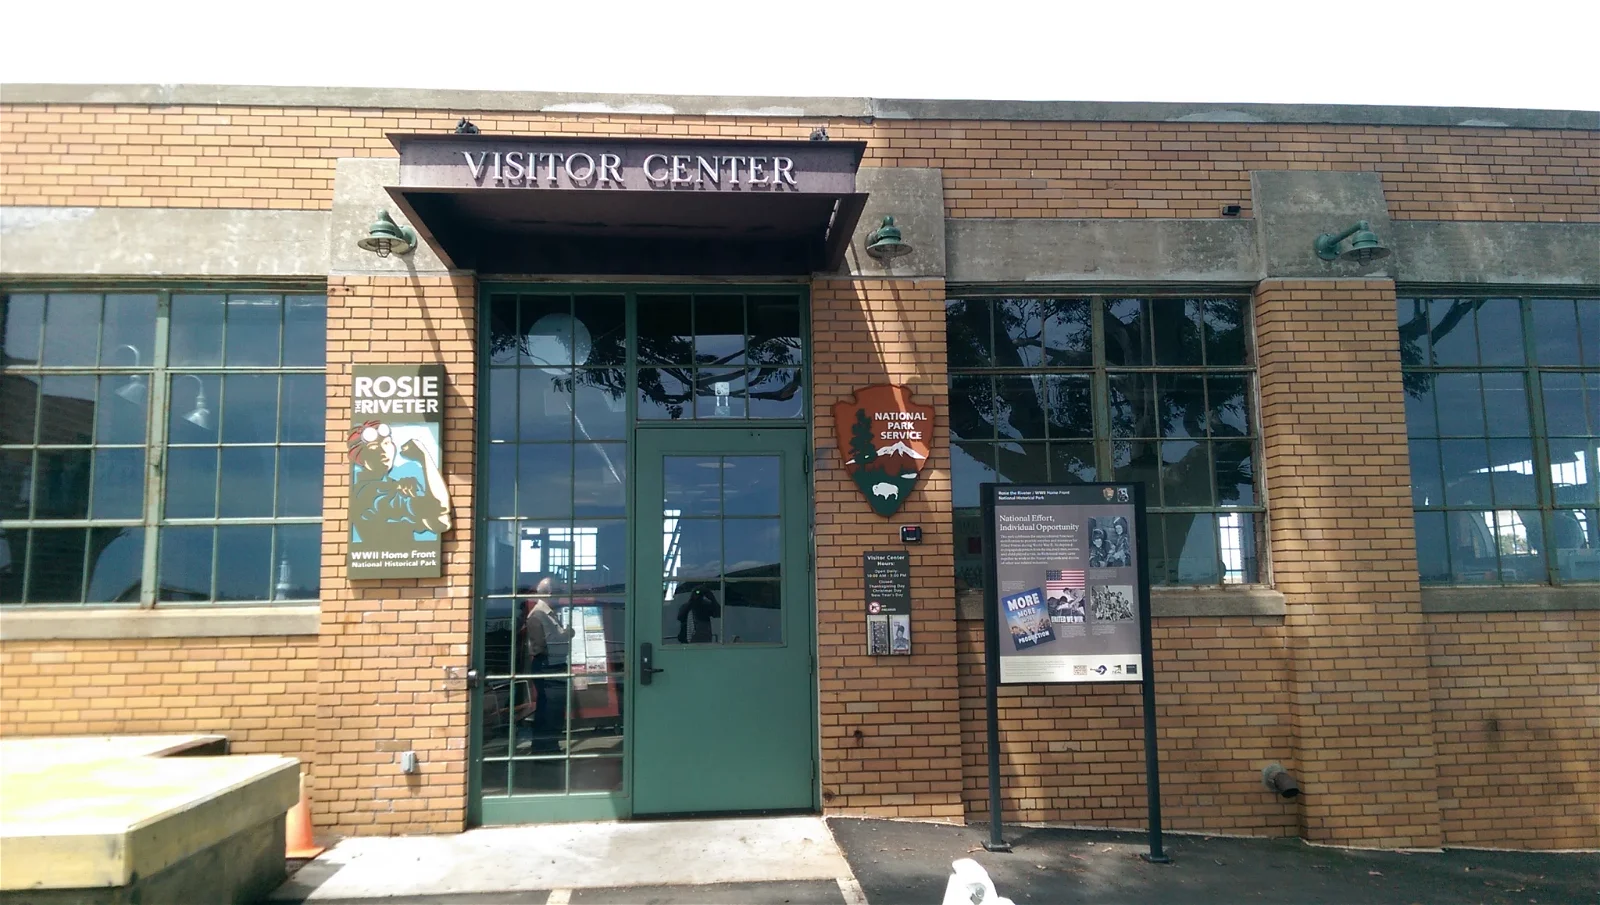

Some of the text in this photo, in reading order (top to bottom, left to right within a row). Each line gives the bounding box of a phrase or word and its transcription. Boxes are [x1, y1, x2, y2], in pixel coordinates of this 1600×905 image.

[462, 151, 797, 185] VISITOR CENTER
[355, 376, 438, 398] ROSIE
[361, 399, 439, 414] RIVETER
[874, 412, 928, 420] NATIONAL
[887, 421, 915, 430] PARK
[880, 431, 922, 440] SERVICE
[1000, 514, 1055, 523] National Effort,
[1000, 523, 1080, 533] Individual Opportunity
[351, 549, 437, 560] WWII Home Front
[420, 559, 437, 567] Park
[1007, 592, 1040, 611] MORE
[1017, 607, 1036, 617] MORE
[1018, 630, 1050, 644] PRODCTION
